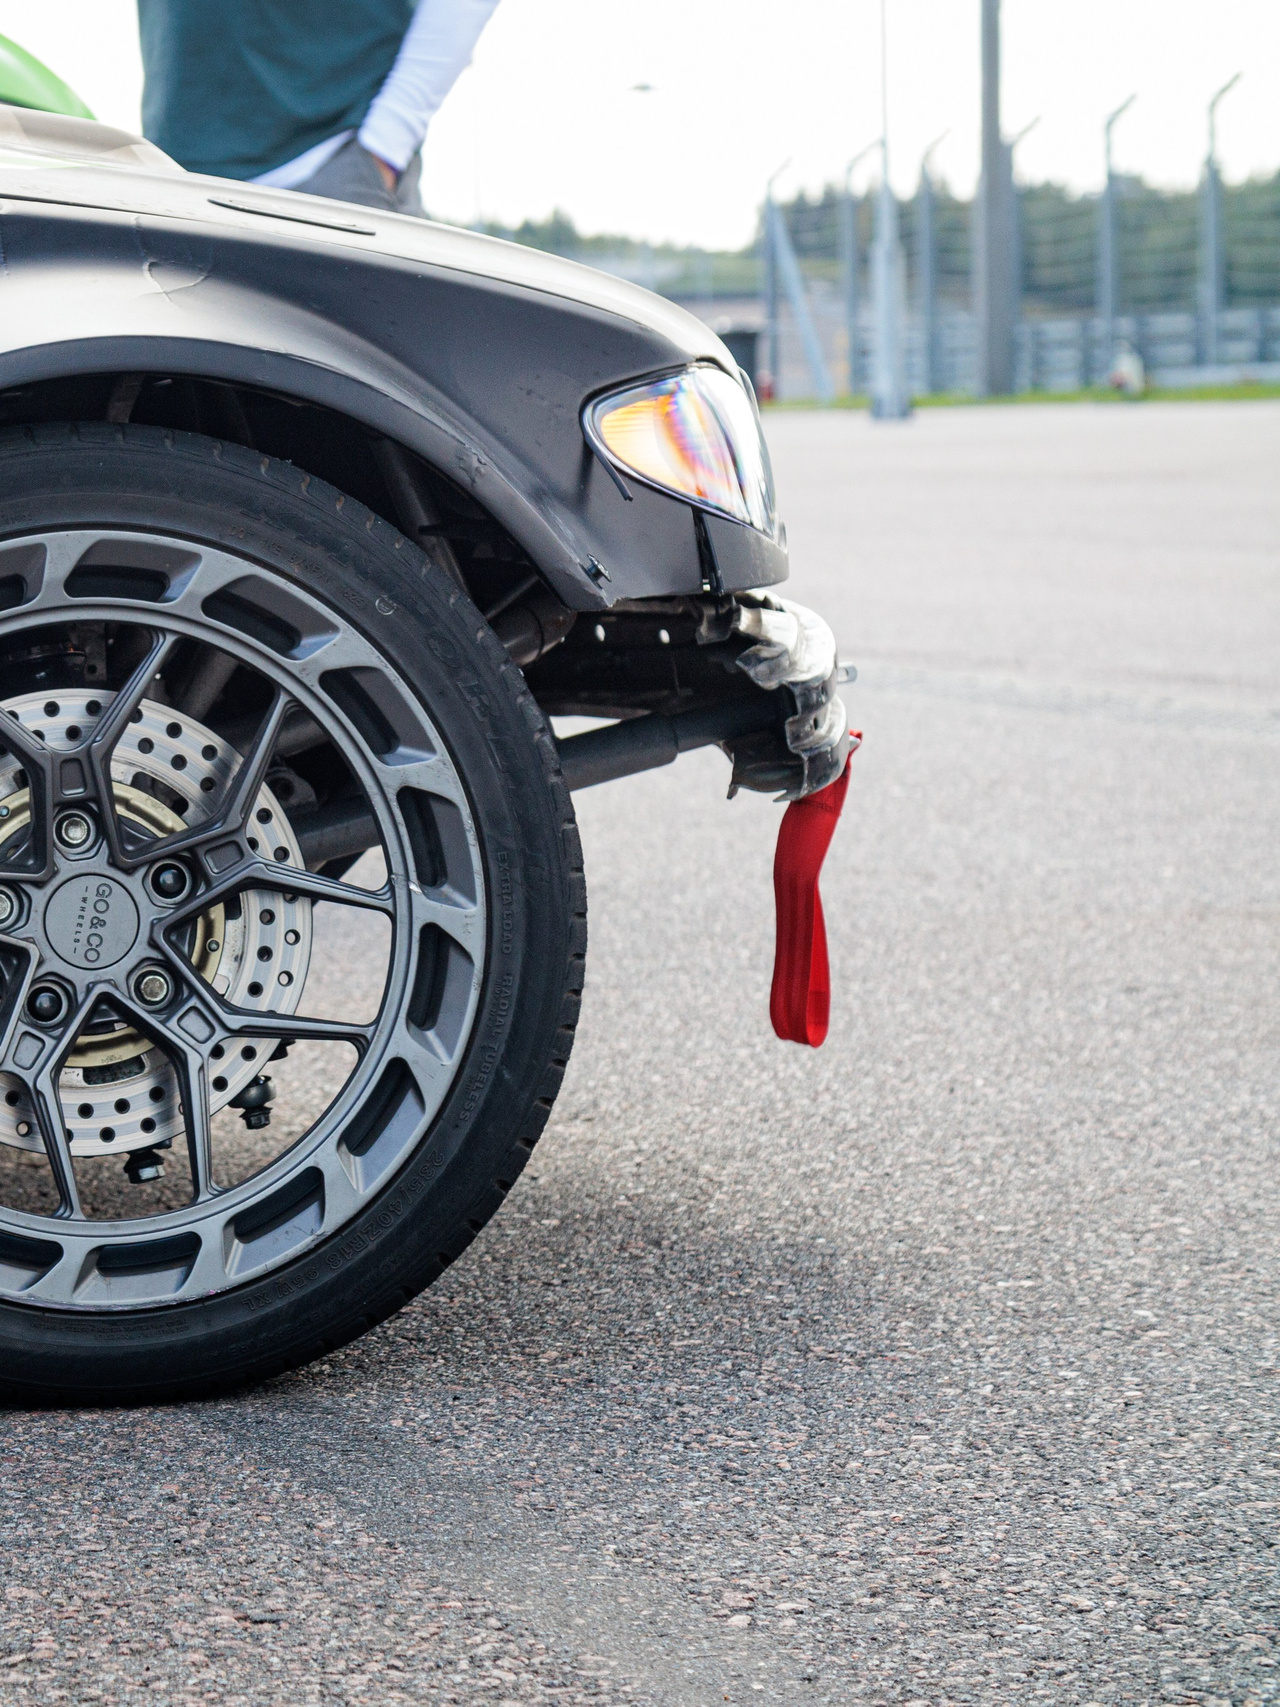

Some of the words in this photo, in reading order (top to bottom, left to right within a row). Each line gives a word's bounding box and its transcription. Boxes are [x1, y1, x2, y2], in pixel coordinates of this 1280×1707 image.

[495, 851, 514, 906] EXTRA
[84, 883, 113, 963] GO&CO
[501, 910, 516, 955] LOAD
[496, 973, 516, 1038] RADIAL
[459, 1040, 497, 1122] TUBELESS
[326, 1150, 445, 1270] 235/40ZR18
[242, 1292, 270, 1311] XL
